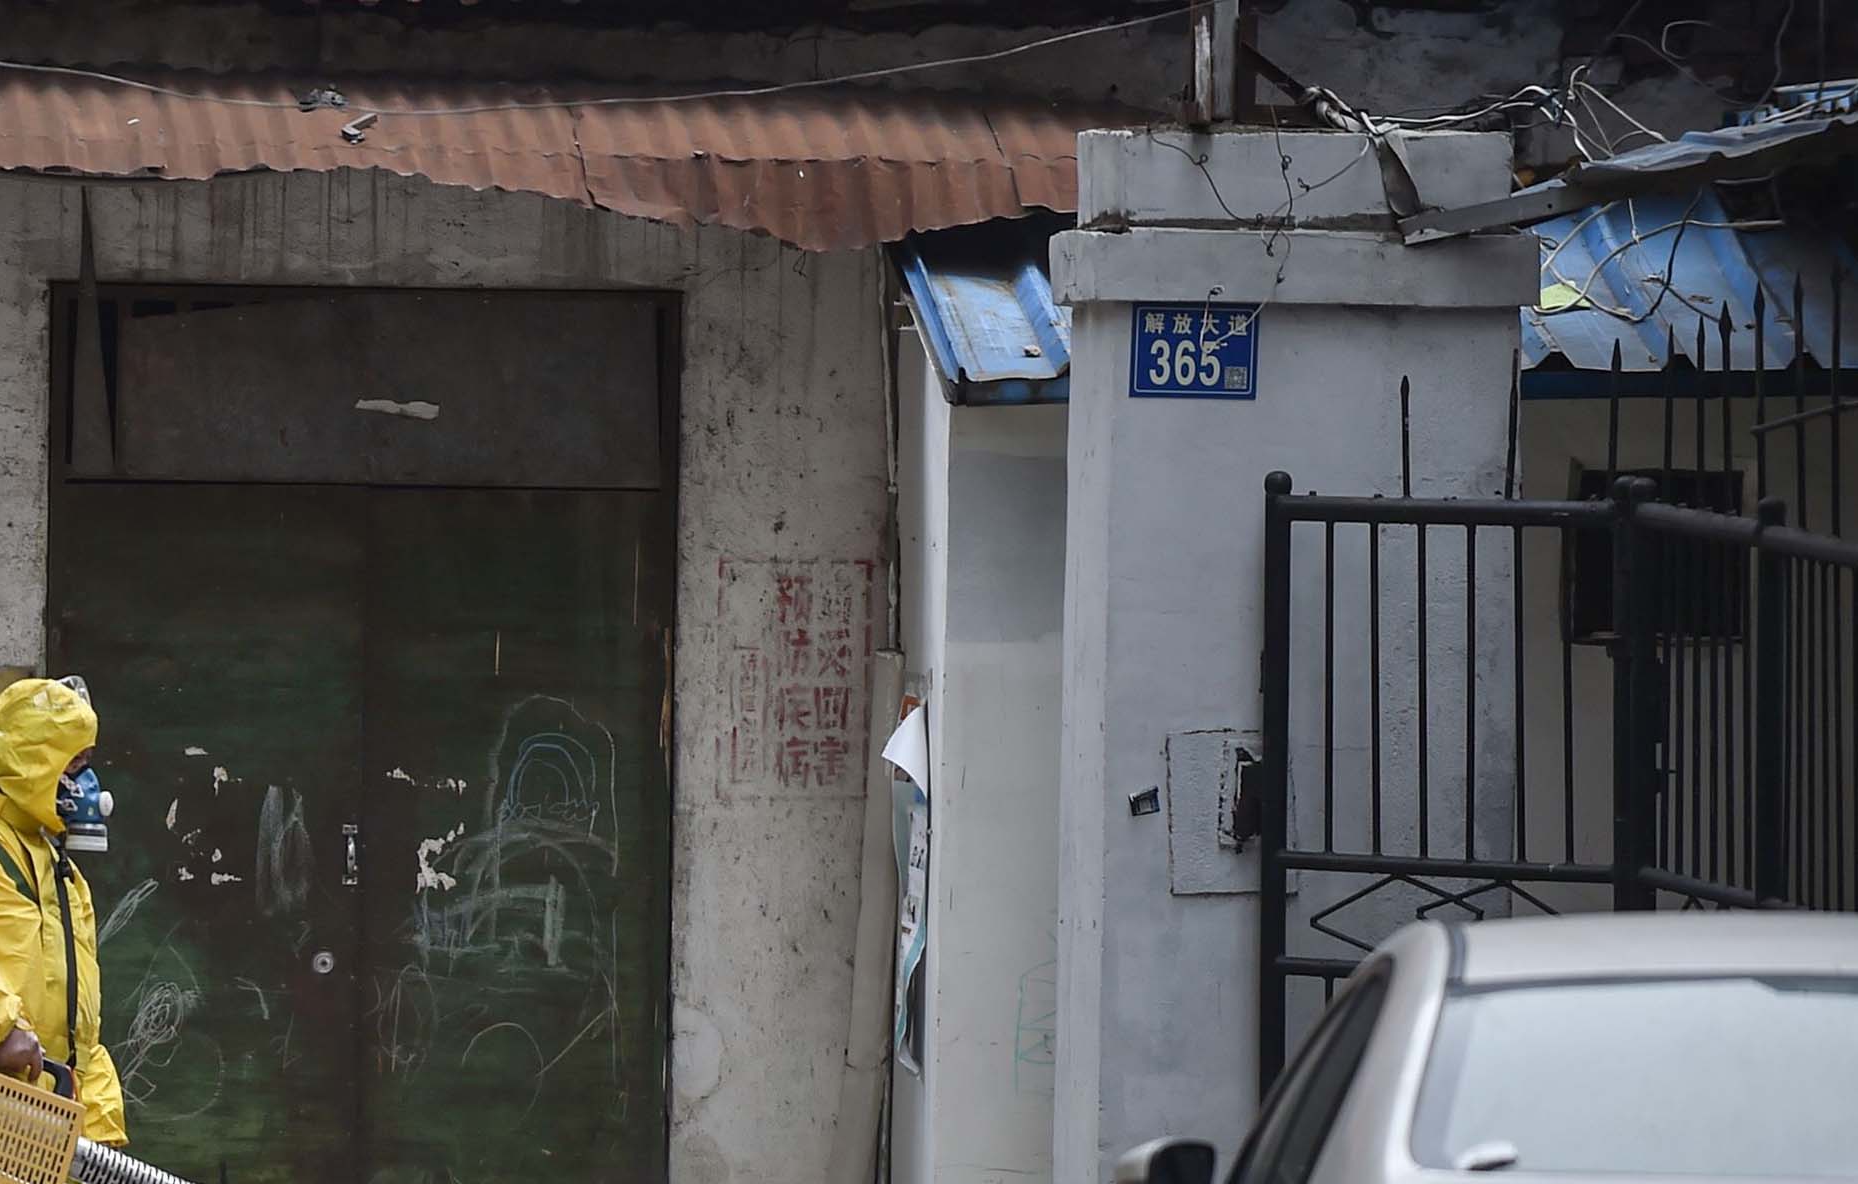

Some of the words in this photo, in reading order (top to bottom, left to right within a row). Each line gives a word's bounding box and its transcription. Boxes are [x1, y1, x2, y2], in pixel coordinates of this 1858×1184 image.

[1144, 312, 1248, 336] 解放大道
[1149, 339, 1221, 386] 365
